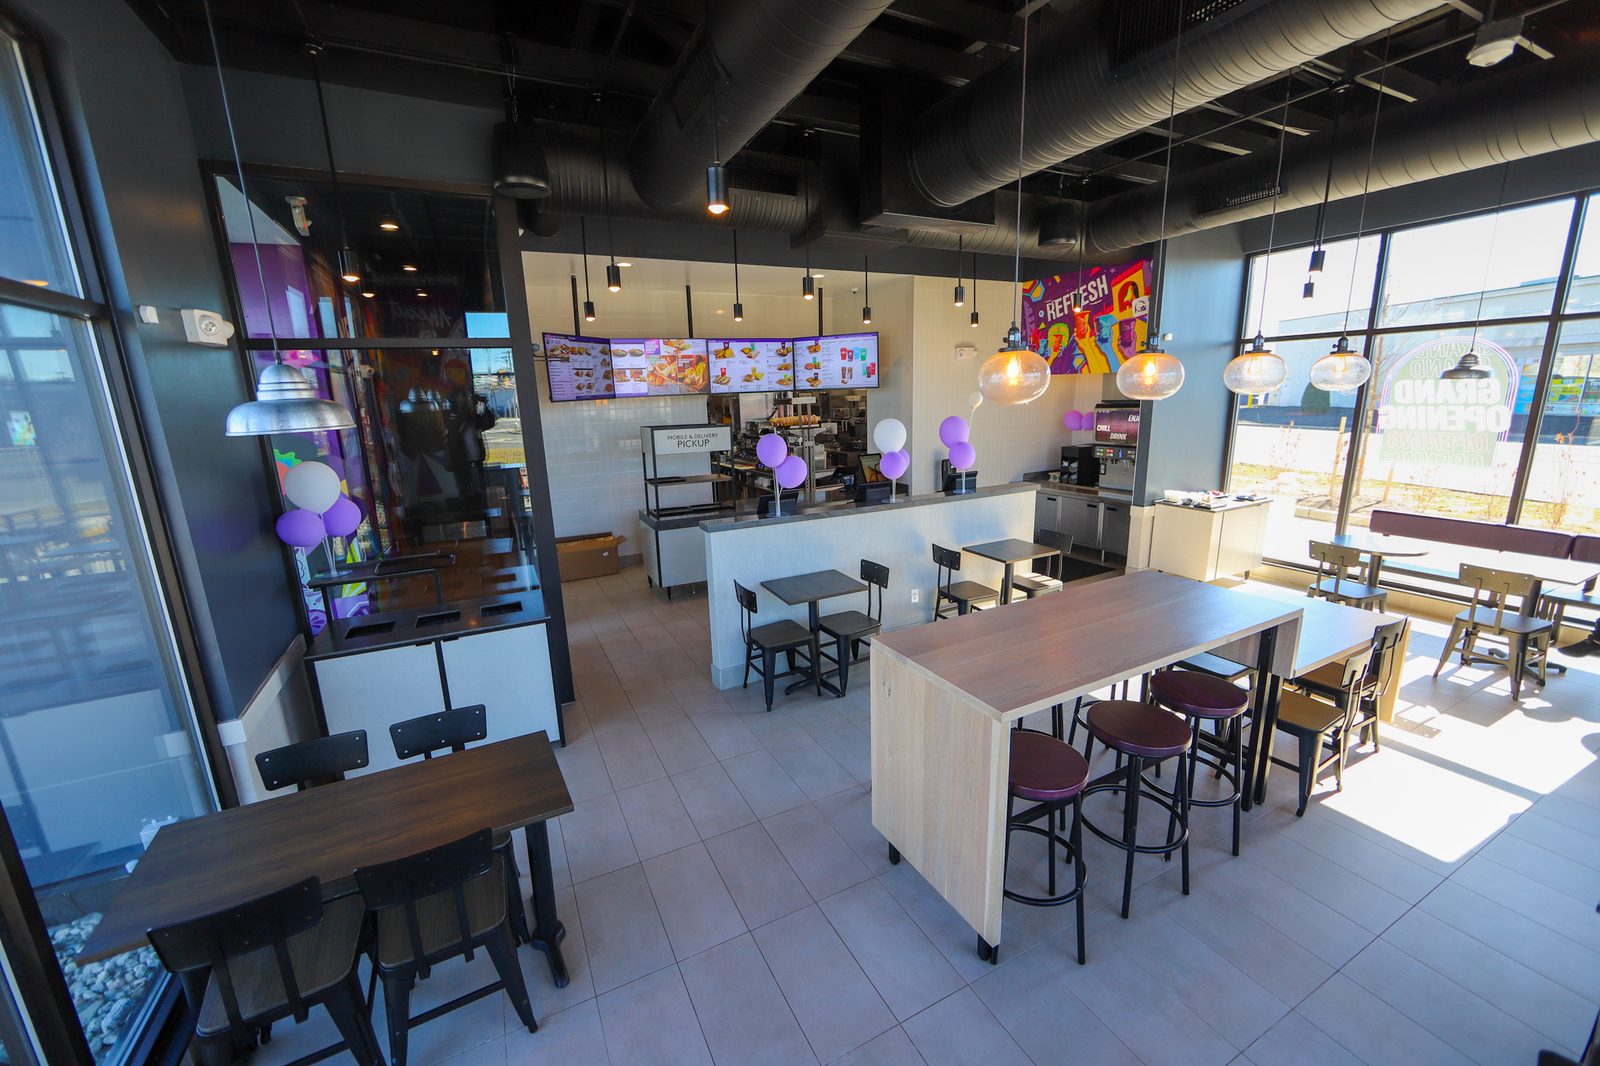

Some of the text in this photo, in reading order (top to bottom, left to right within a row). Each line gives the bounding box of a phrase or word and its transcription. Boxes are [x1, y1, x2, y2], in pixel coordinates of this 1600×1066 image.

[1096, 424, 1111, 432] CHILL
[1109, 432, 1128, 440] DRINK
[677, 439, 710, 448] PICKUP
